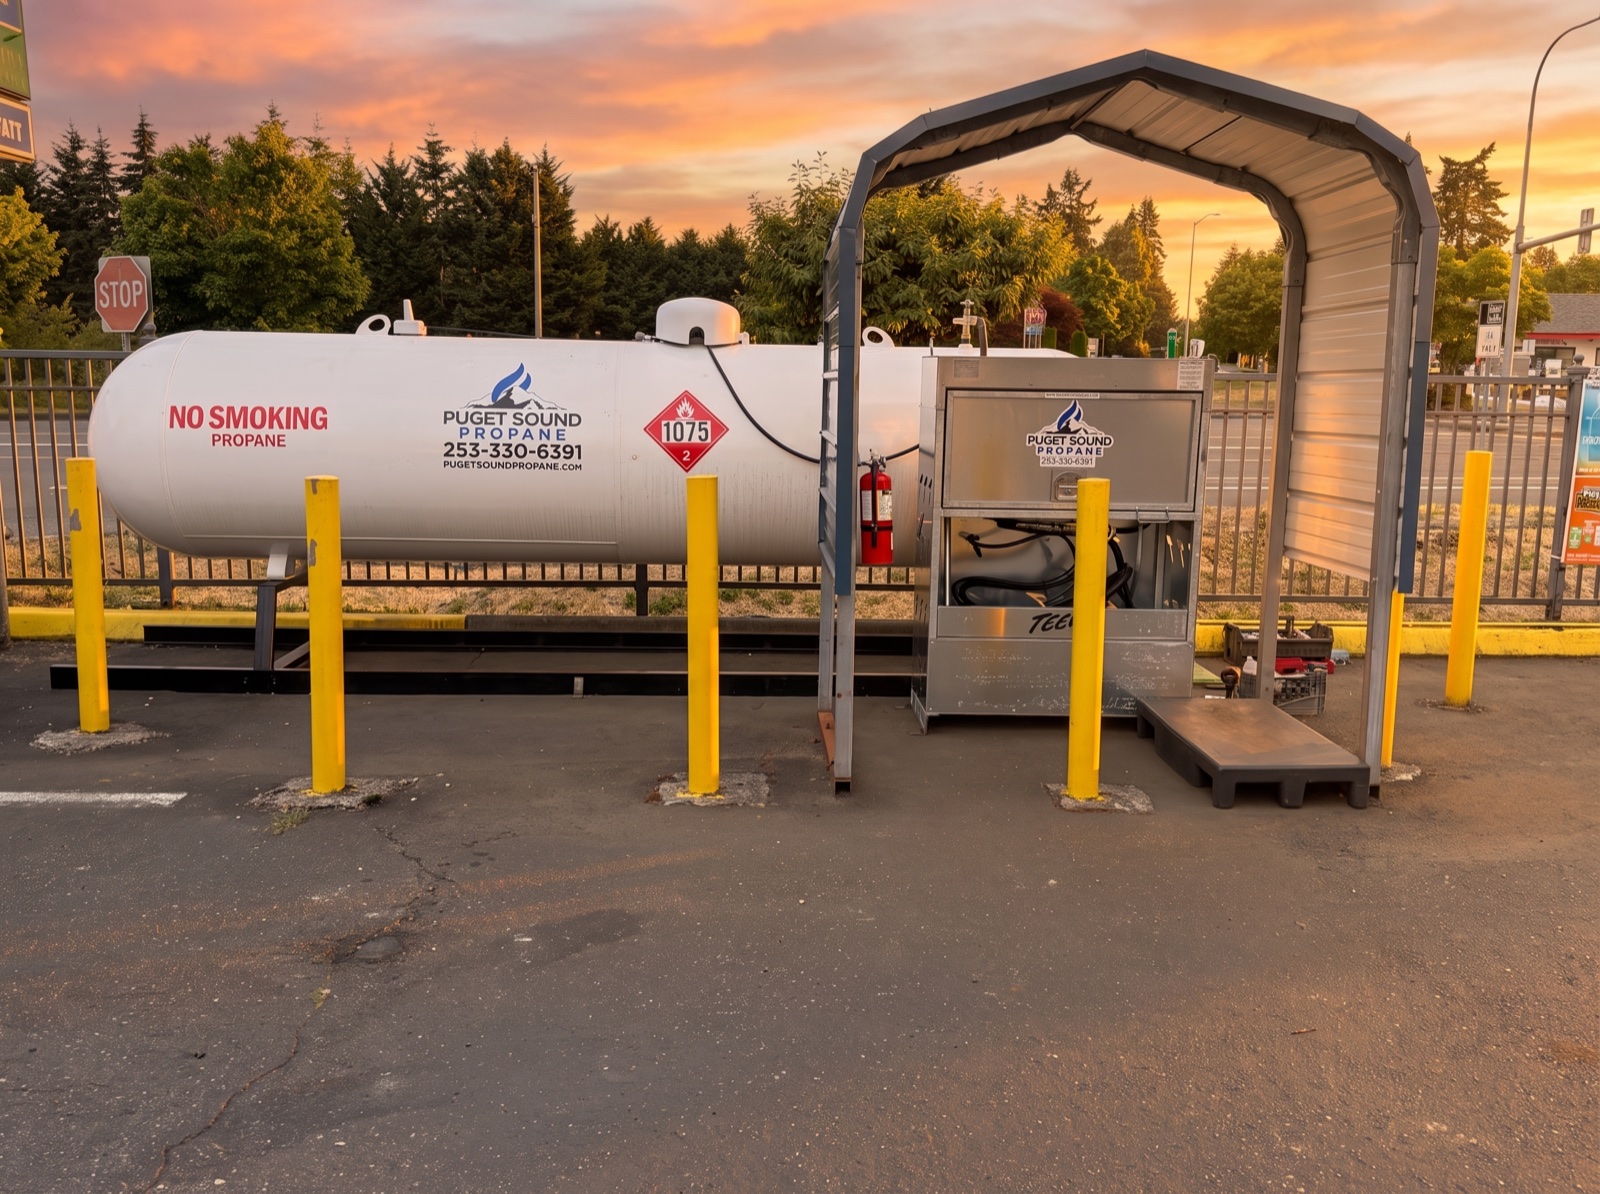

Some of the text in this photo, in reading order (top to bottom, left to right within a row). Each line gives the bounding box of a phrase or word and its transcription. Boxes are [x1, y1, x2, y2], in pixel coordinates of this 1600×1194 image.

[0, 116, 22, 142] ATT
[99, 280, 143, 309] STOP
[169, 405, 328, 430] NO SMOKING
[443, 410, 582, 427] PUGET SOUND
[459, 427, 566, 441] PROPANE
[663, 421, 709, 442] 1075
[211, 433, 286, 447] PROPANE
[1028, 436, 1112, 446] PUGET SOUND
[443, 442, 582, 460] 253-330-6391
[682, 450, 691, 461] 2
[1037, 447, 1102, 456] PROPANE
[443, 460, 582, 471] PUGETSOUNDPROPANE.COM
[1041, 457, 1093, 465] 253-330-6391
